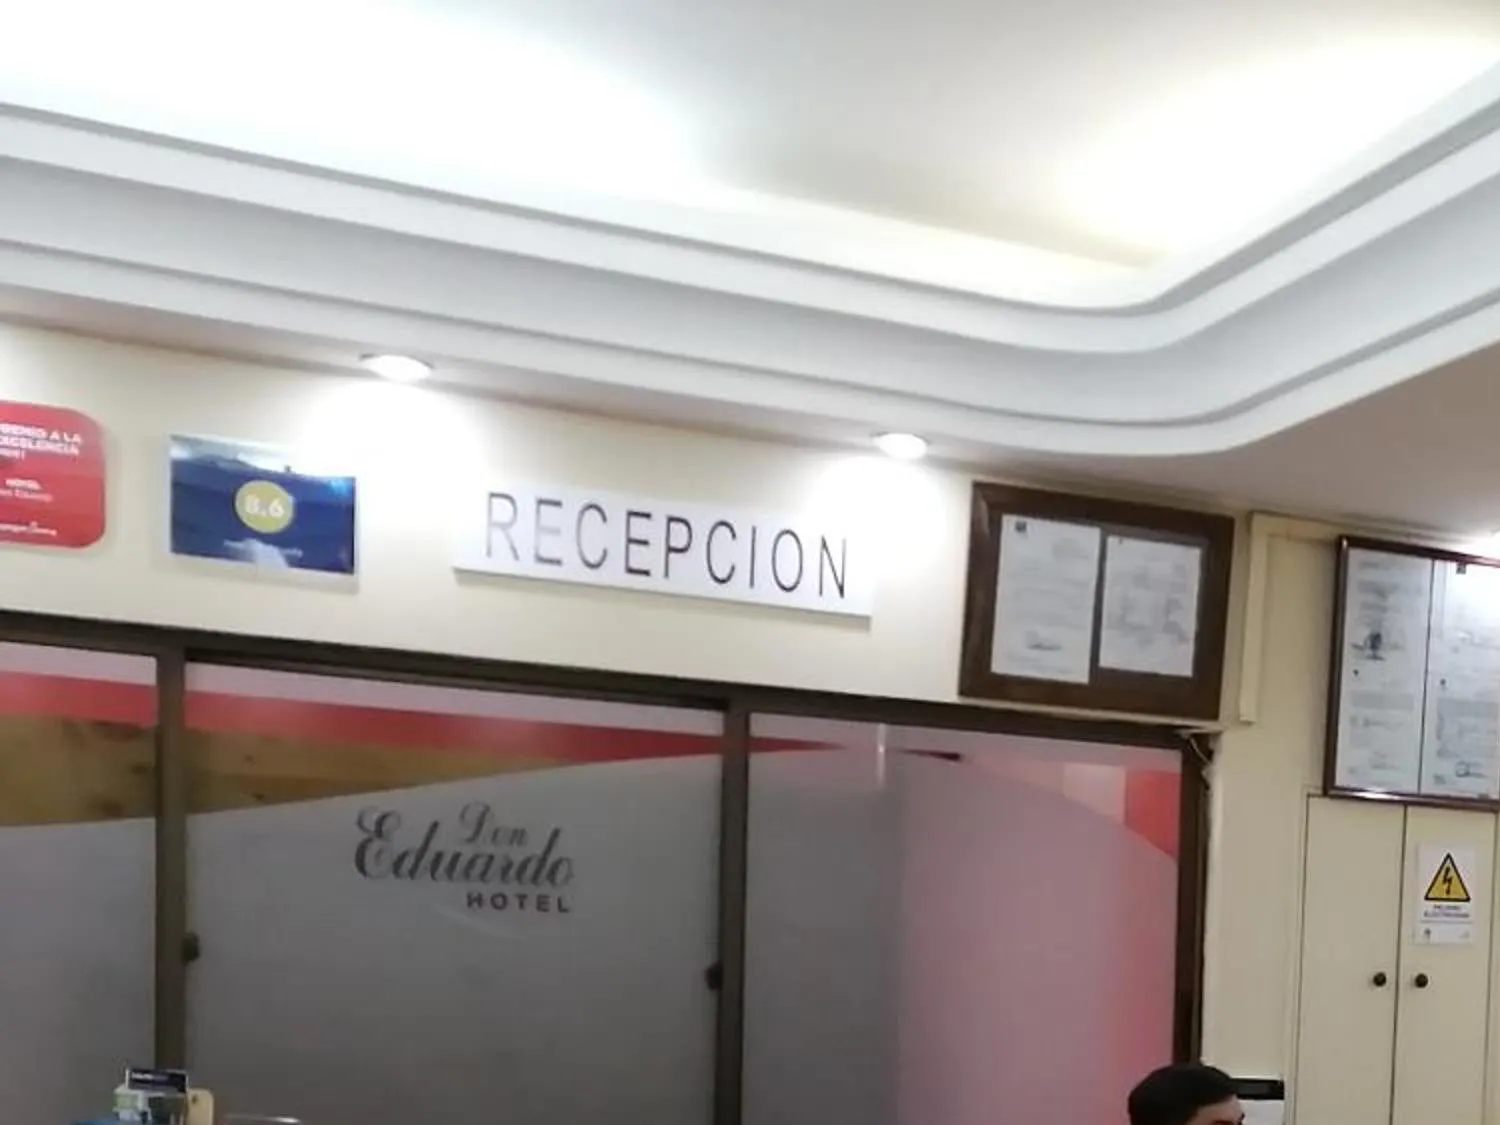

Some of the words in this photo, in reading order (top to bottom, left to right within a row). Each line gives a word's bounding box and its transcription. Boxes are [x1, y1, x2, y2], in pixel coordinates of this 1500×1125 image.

[485, 491, 847, 599] RECEPCION
[354, 806, 576, 887] Eduardo
[459, 801, 528, 847] Don
[466, 891, 571, 914] HOTEL
